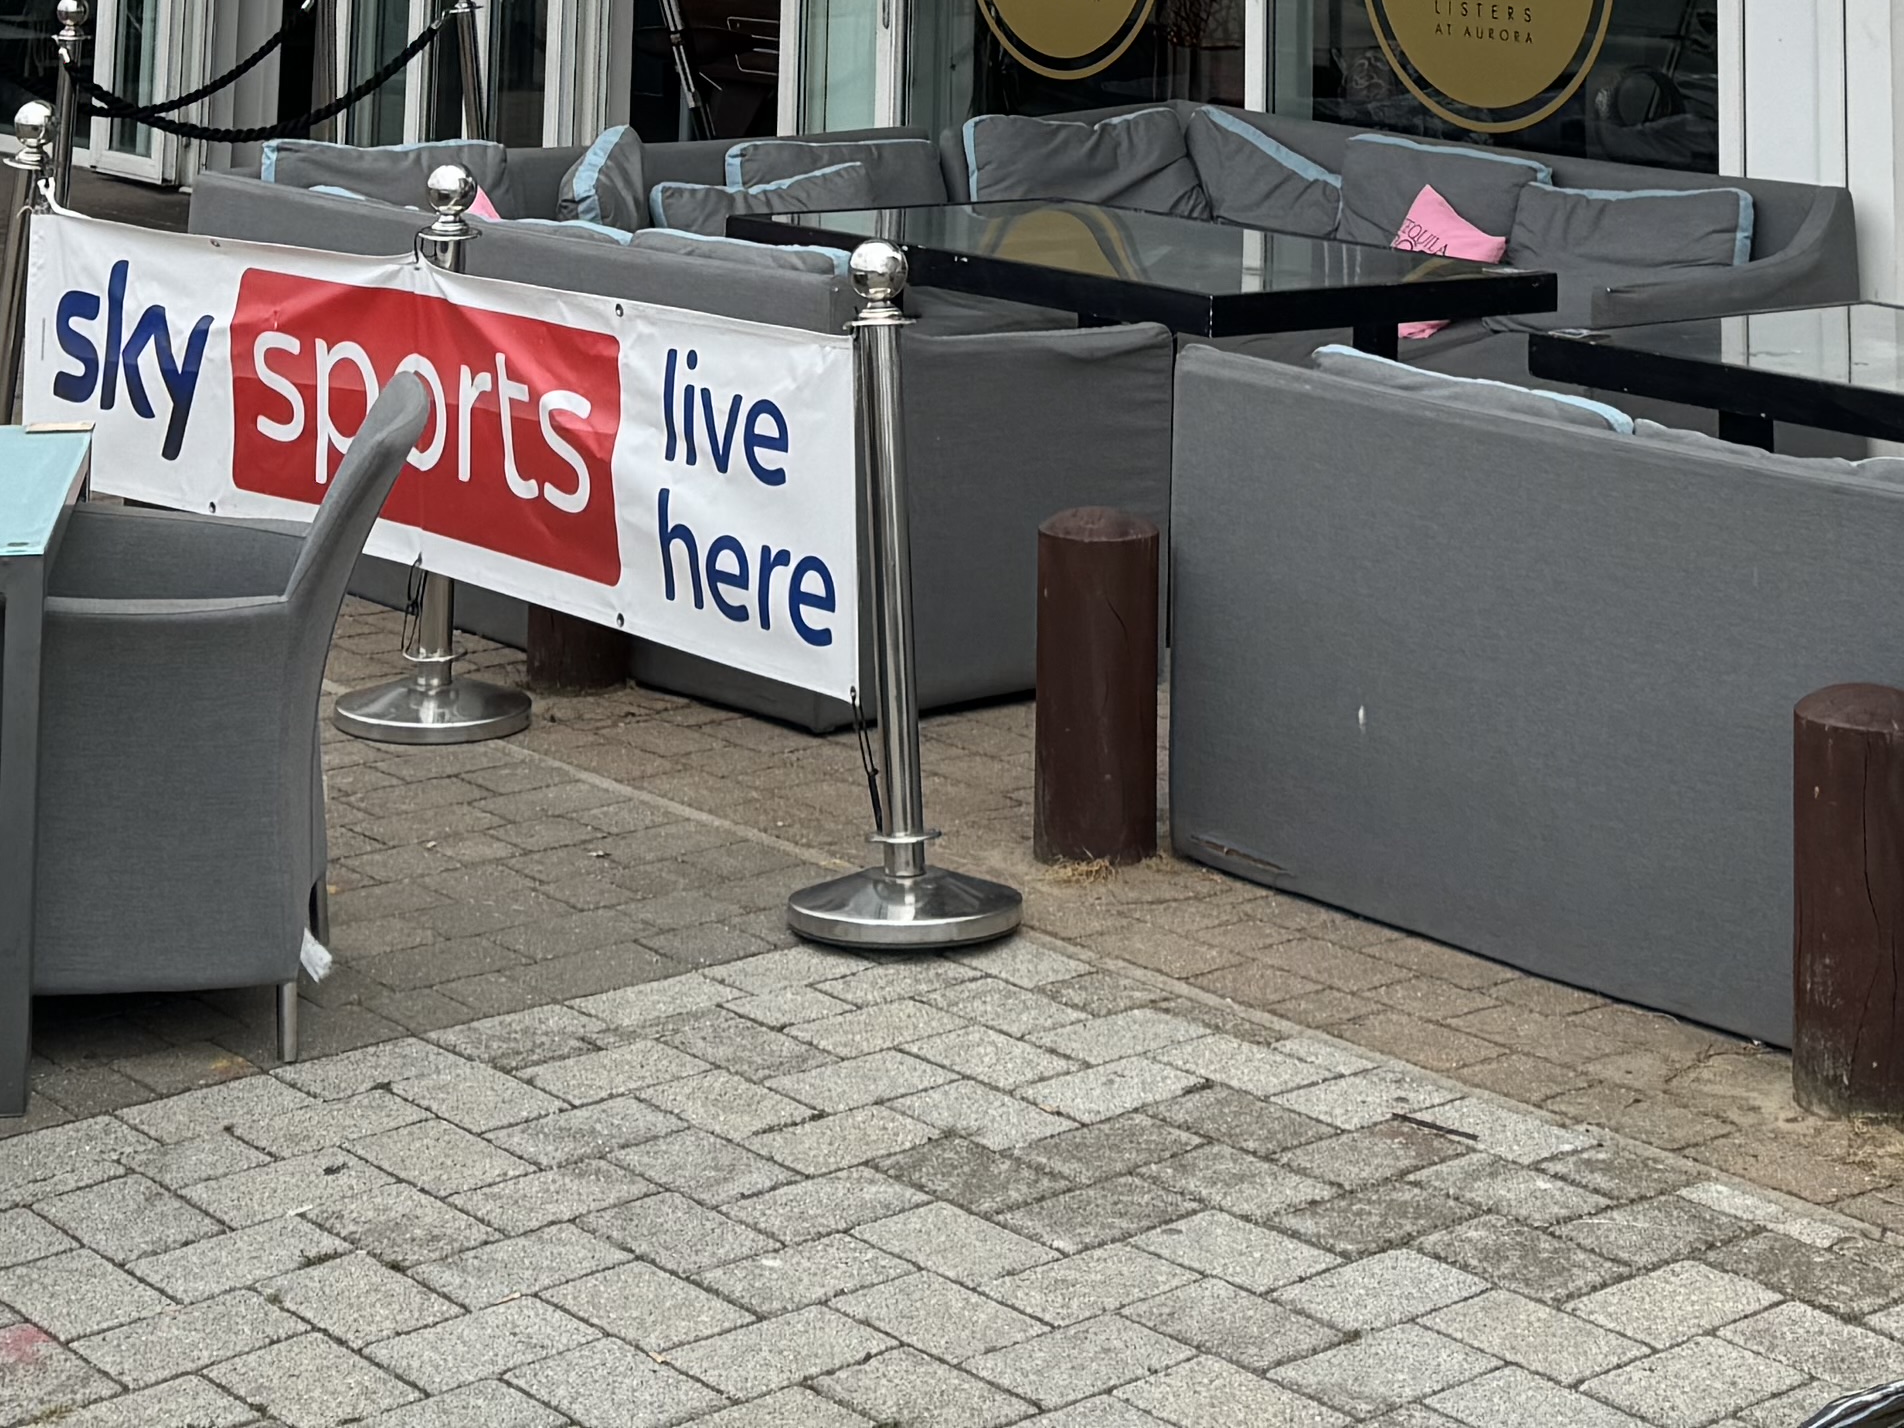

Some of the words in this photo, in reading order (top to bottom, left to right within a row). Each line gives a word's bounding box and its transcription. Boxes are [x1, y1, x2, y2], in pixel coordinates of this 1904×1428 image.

[1434, 0, 1532, 23] LISTERS
[1434, 23, 1452, 36] AT
[1463, 26, 1533, 44] AURORA
[52, 259, 215, 461] sky
[253, 329, 592, 514] sports
[662, 348, 790, 487] live
[656, 487, 837, 647] here
